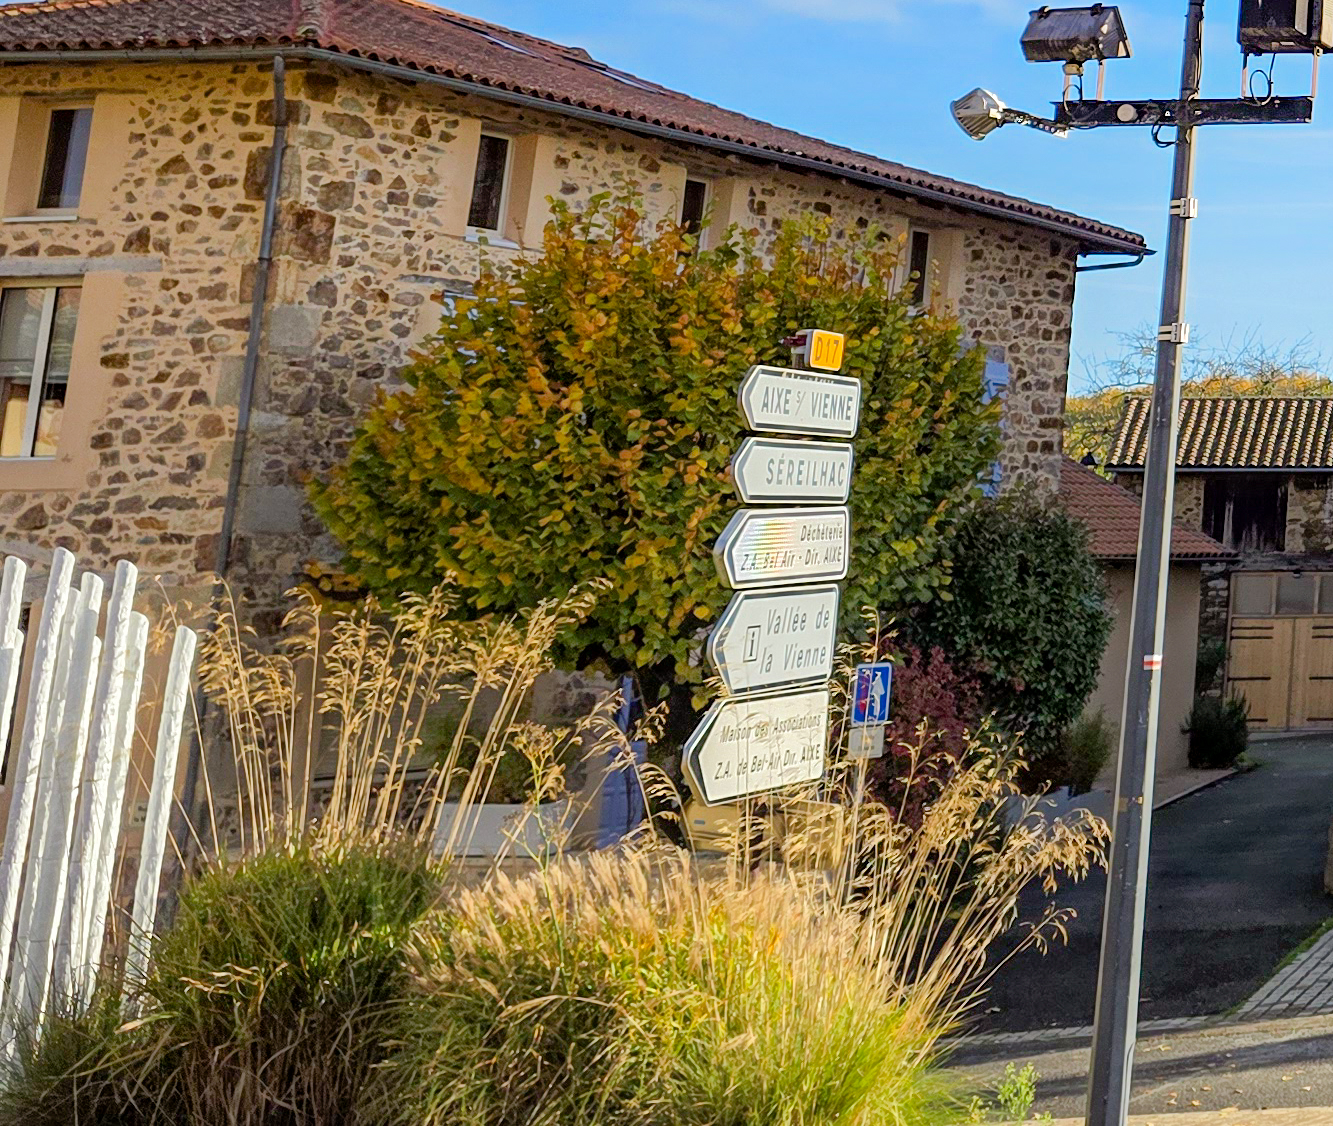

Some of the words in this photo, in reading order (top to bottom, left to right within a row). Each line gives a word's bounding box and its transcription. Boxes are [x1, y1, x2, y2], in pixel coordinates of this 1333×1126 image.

[814, 336, 840, 364] D17
[761, 386, 791, 414] AIXE
[812, 392, 853, 420] VIENNE
[766, 453, 845, 486] SÉREILHAC
[805, 548, 821, 565] Dir.
[823, 546, 842, 563] AIXE
[767, 605, 807, 635] Vallée
[815, 604, 829, 629] de
[760, 647, 773, 674] la
[784, 643, 826, 670] Vienne
[720, 724, 752, 743] Maison
[714, 761, 732, 779] Z.A.
[737, 758, 748, 775] de
[800, 743, 820, 762] AIXE
